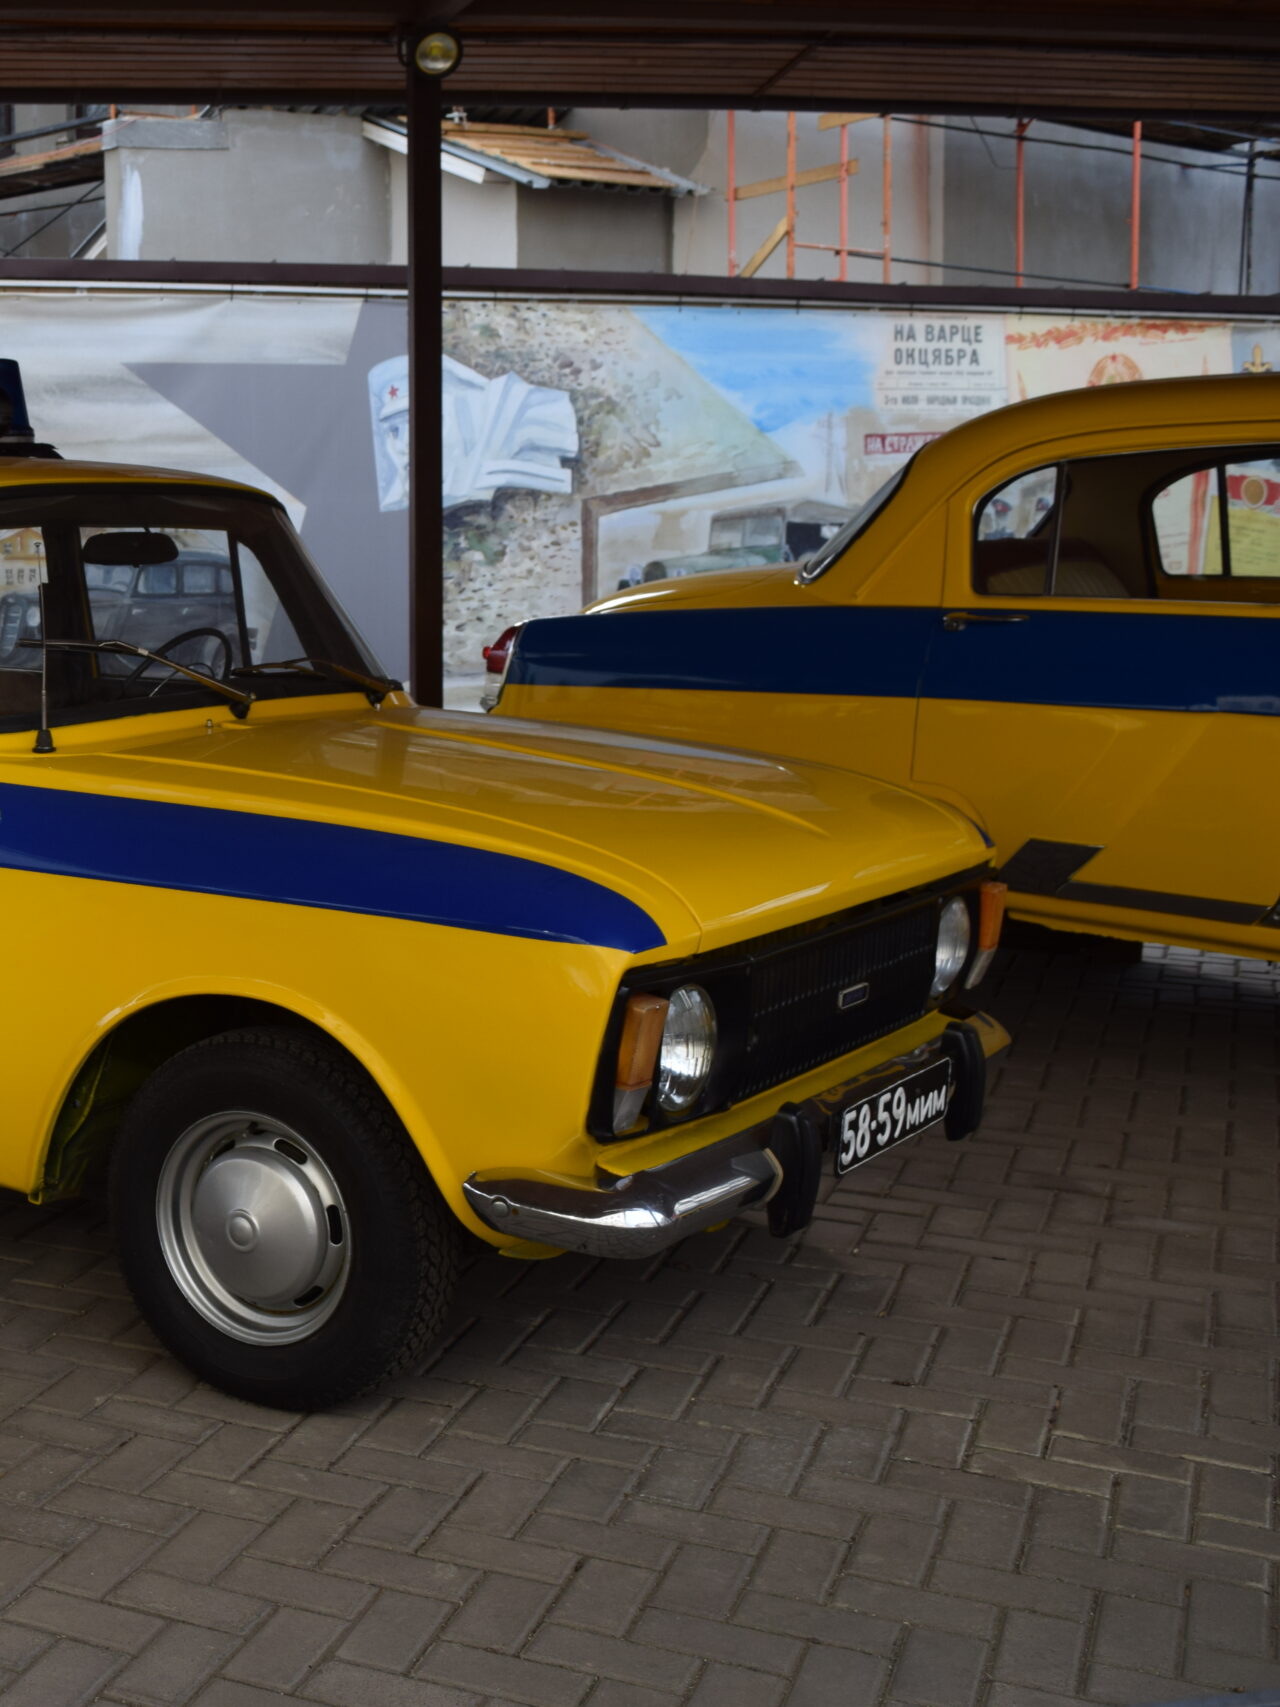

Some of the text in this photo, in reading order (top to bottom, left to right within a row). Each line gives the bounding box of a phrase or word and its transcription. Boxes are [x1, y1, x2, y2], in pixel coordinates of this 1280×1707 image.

[894, 323, 983, 345] НА ВАРЦЕ
[894, 348, 980, 367] ОКЦЯБРА
